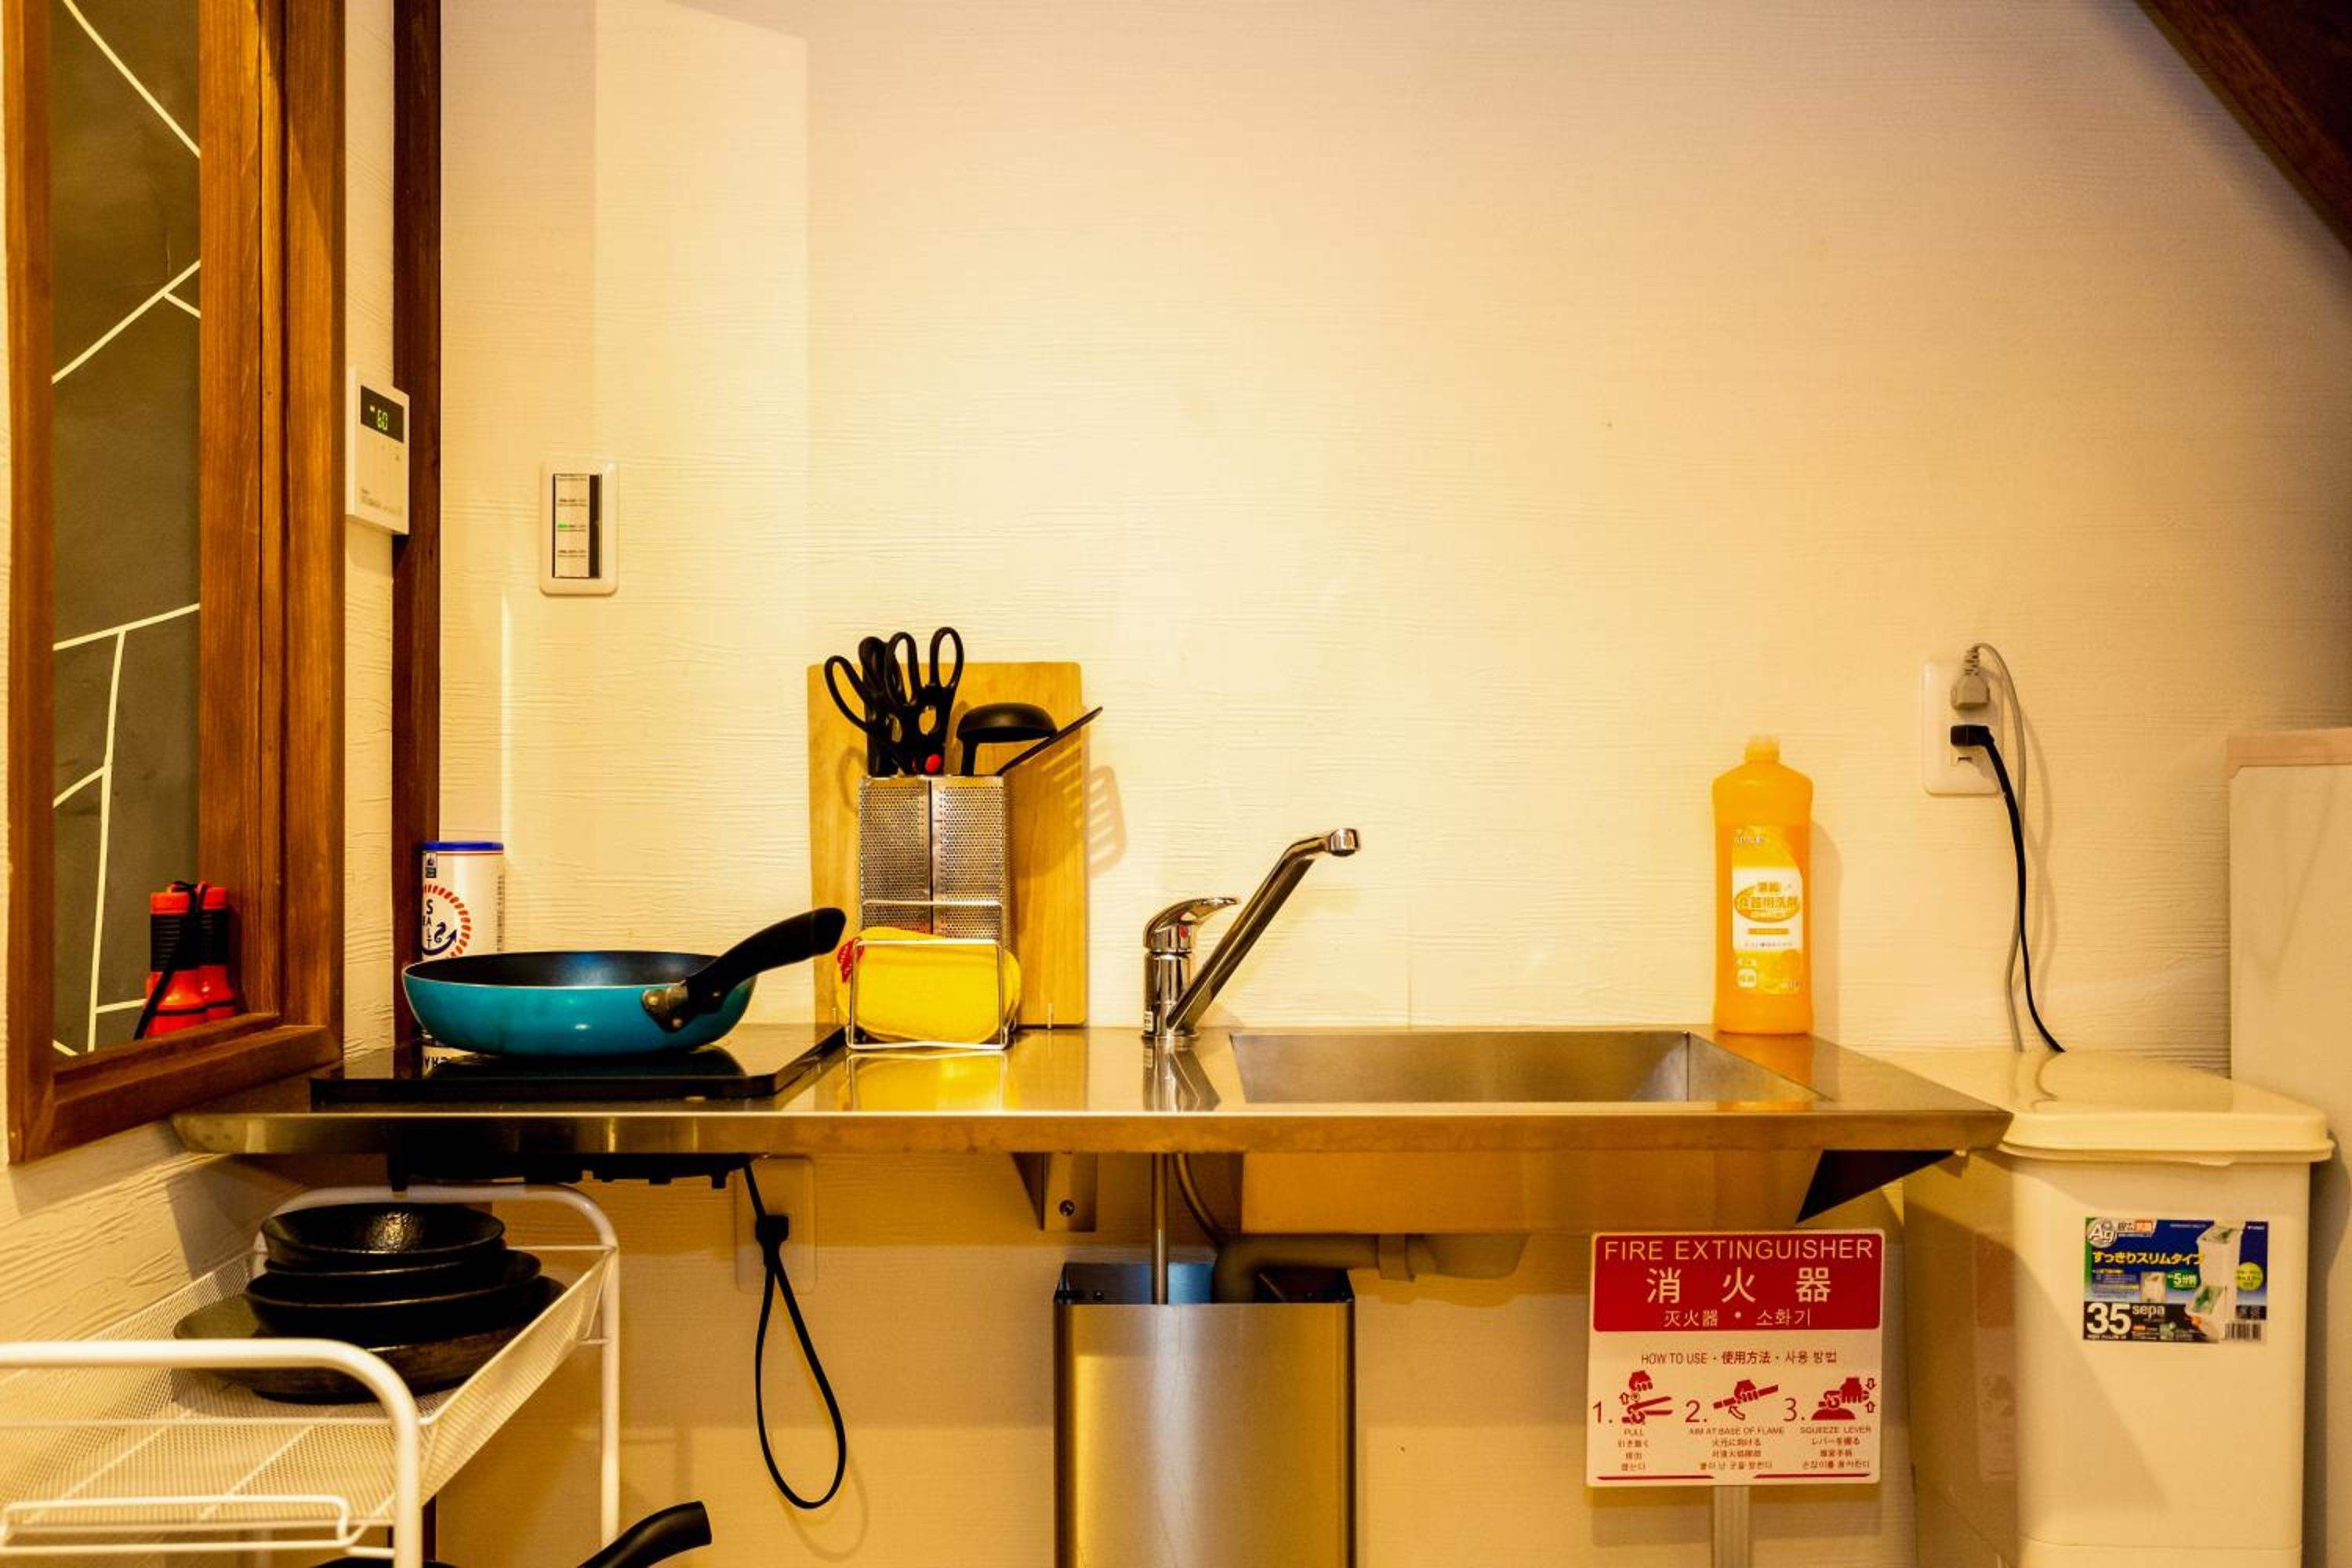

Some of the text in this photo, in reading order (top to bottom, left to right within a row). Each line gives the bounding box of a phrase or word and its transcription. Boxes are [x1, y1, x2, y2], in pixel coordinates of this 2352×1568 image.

[2089, 1224, 2114, 1243] Ag
[1605, 1239, 1873, 1261] FIRE EXTINGUISHER
[1664, 1309, 1719, 1327] 灭火器
[1756, 1308, 1811, 1327] 소화기
[2086, 1302, 2132, 1335] 35
[2132, 1305, 2165, 1318] sepa
[1641, 1352, 1708, 1365] HOW TO USE
[1721, 1350, 1771, 1365] 使用方法
